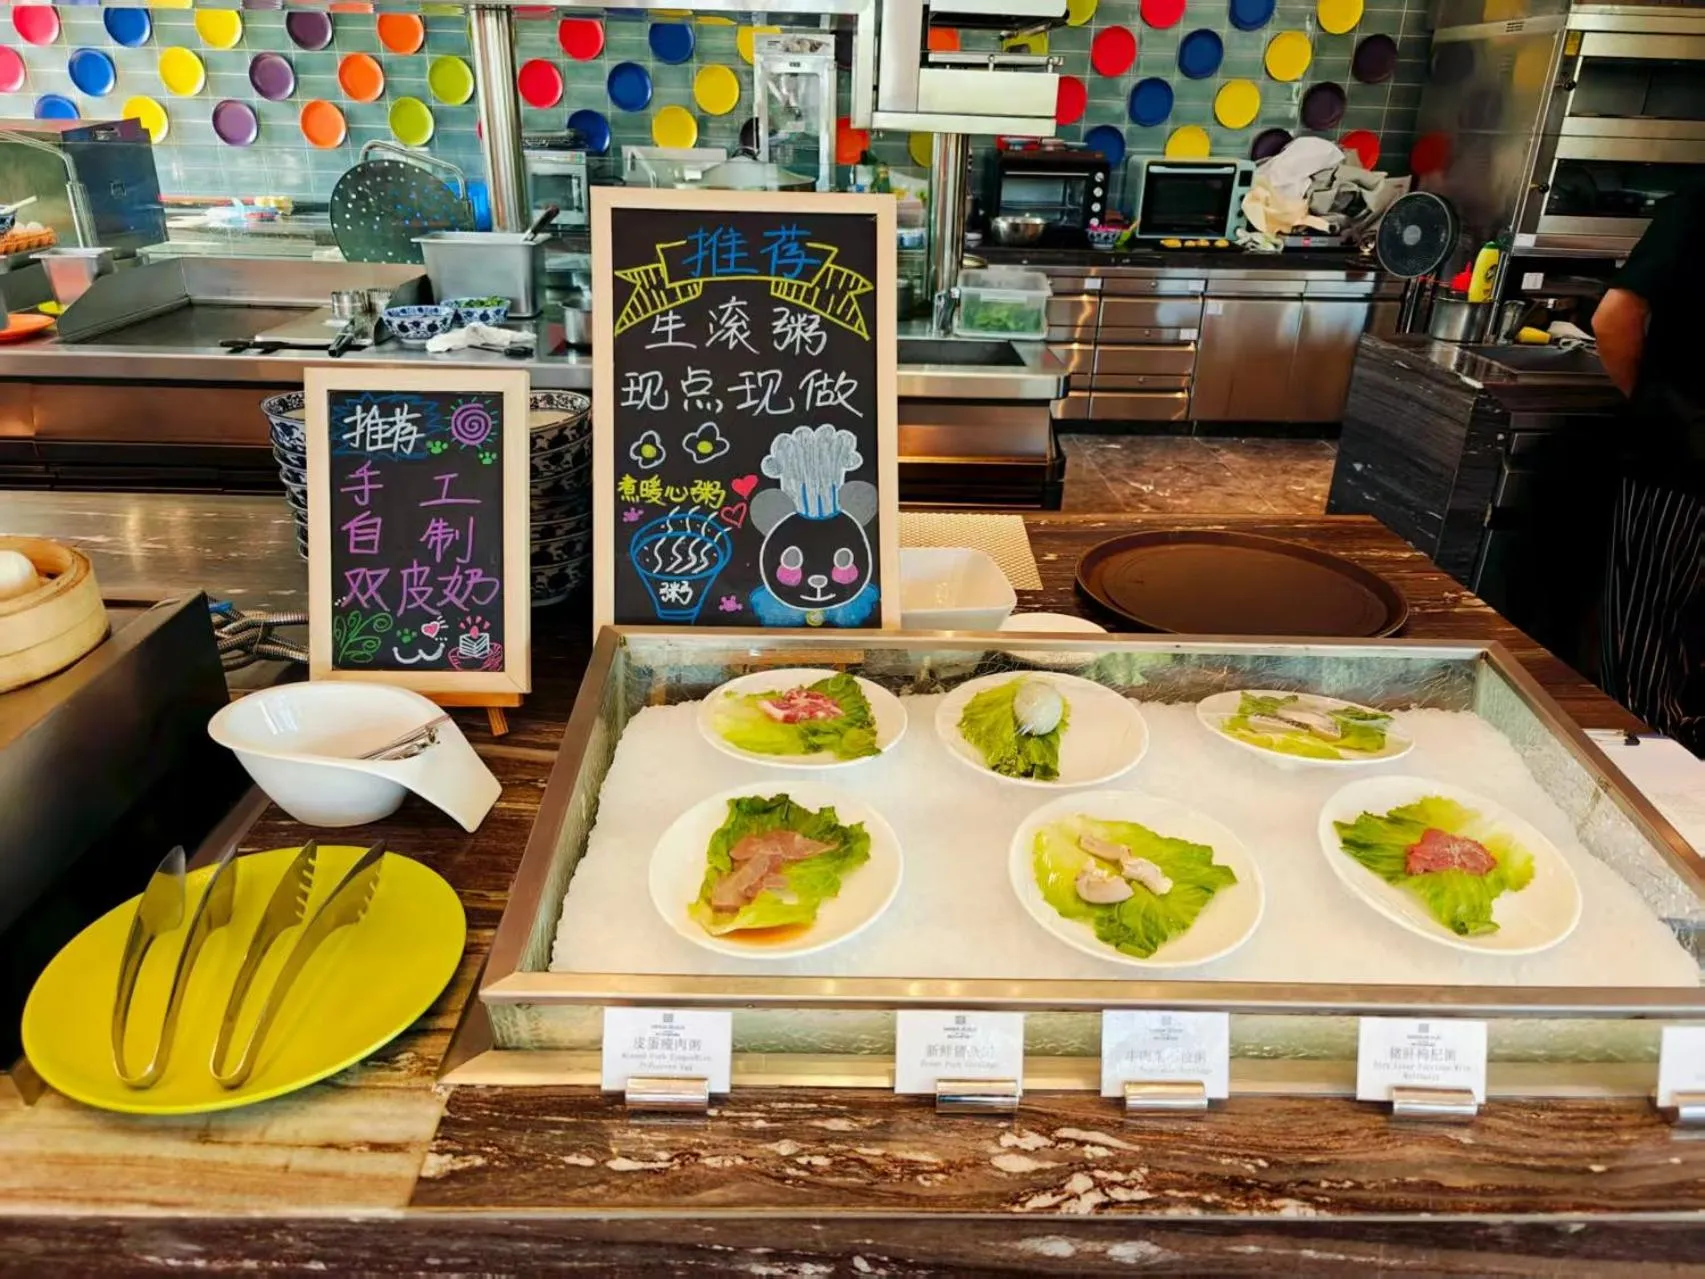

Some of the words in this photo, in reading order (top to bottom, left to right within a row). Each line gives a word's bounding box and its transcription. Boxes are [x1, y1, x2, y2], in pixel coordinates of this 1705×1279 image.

[682, 224, 821, 278] 推荐
[645, 295, 828, 355] 生滚粥
[621, 366, 864, 418] 现点现做
[342, 403, 425, 455] 推荐
[617, 473, 726, 507] 煮暖心粥
[340, 510, 475, 565] 自制
[341, 558, 500, 618] 双皮奶
[658, 581, 693, 603] 粥
